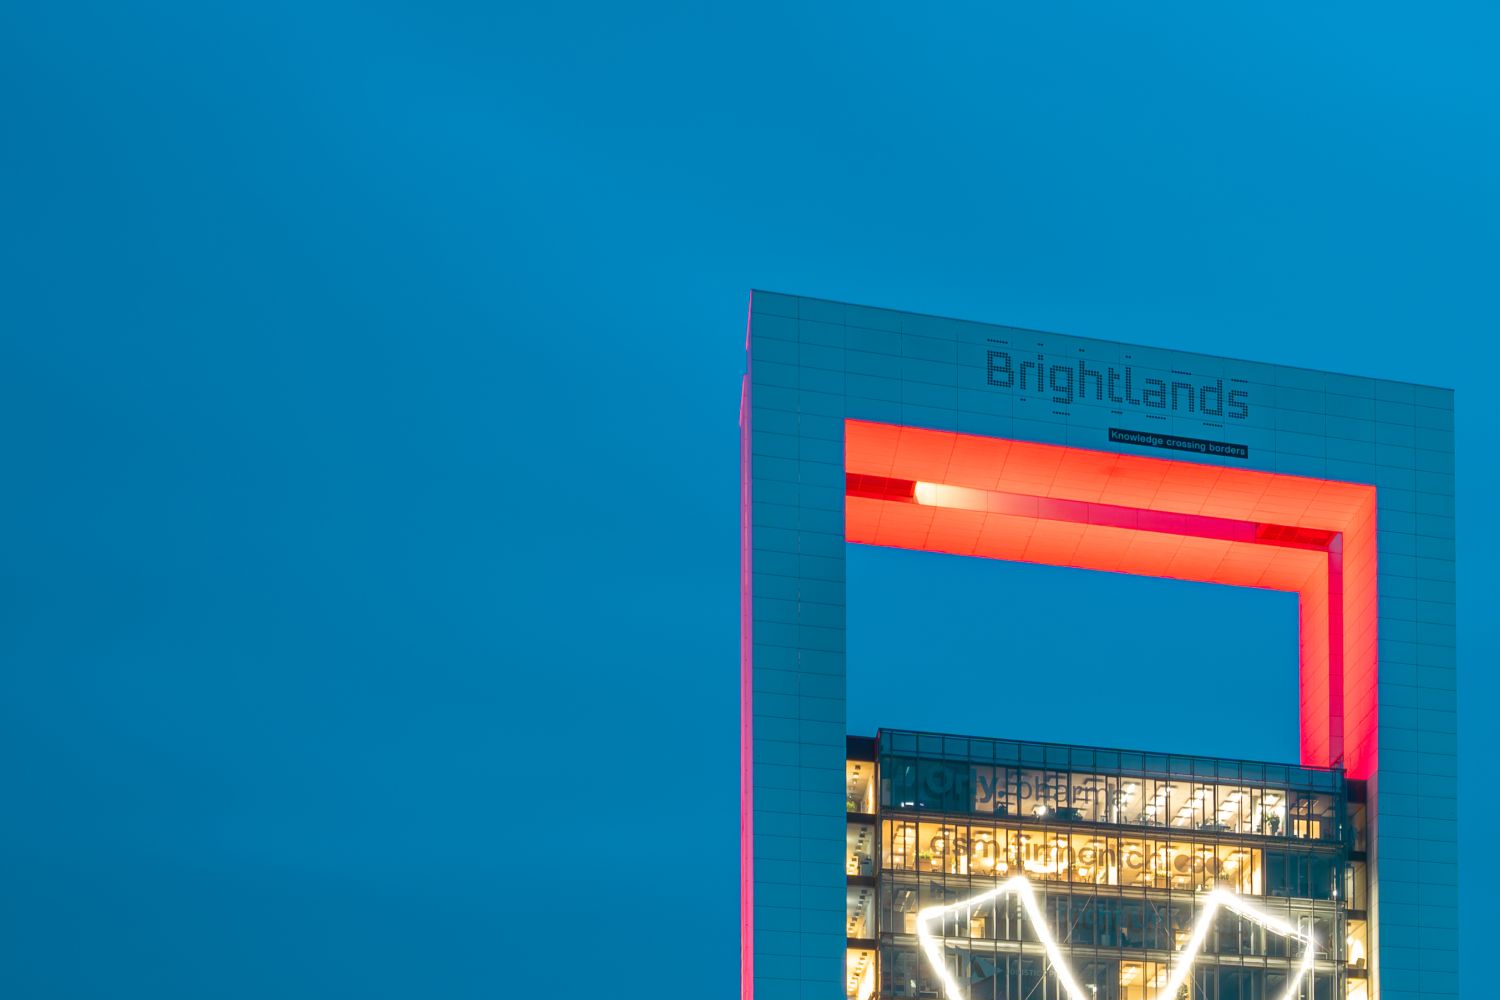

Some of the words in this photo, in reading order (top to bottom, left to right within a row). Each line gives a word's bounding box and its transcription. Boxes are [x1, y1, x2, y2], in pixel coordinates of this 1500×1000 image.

[987, 348, 1249, 421] Brightlands
[1111, 429, 1163, 447] Knowledge
[1166, 437, 1206, 452] crossing
[1209, 442, 1246, 456] borders
